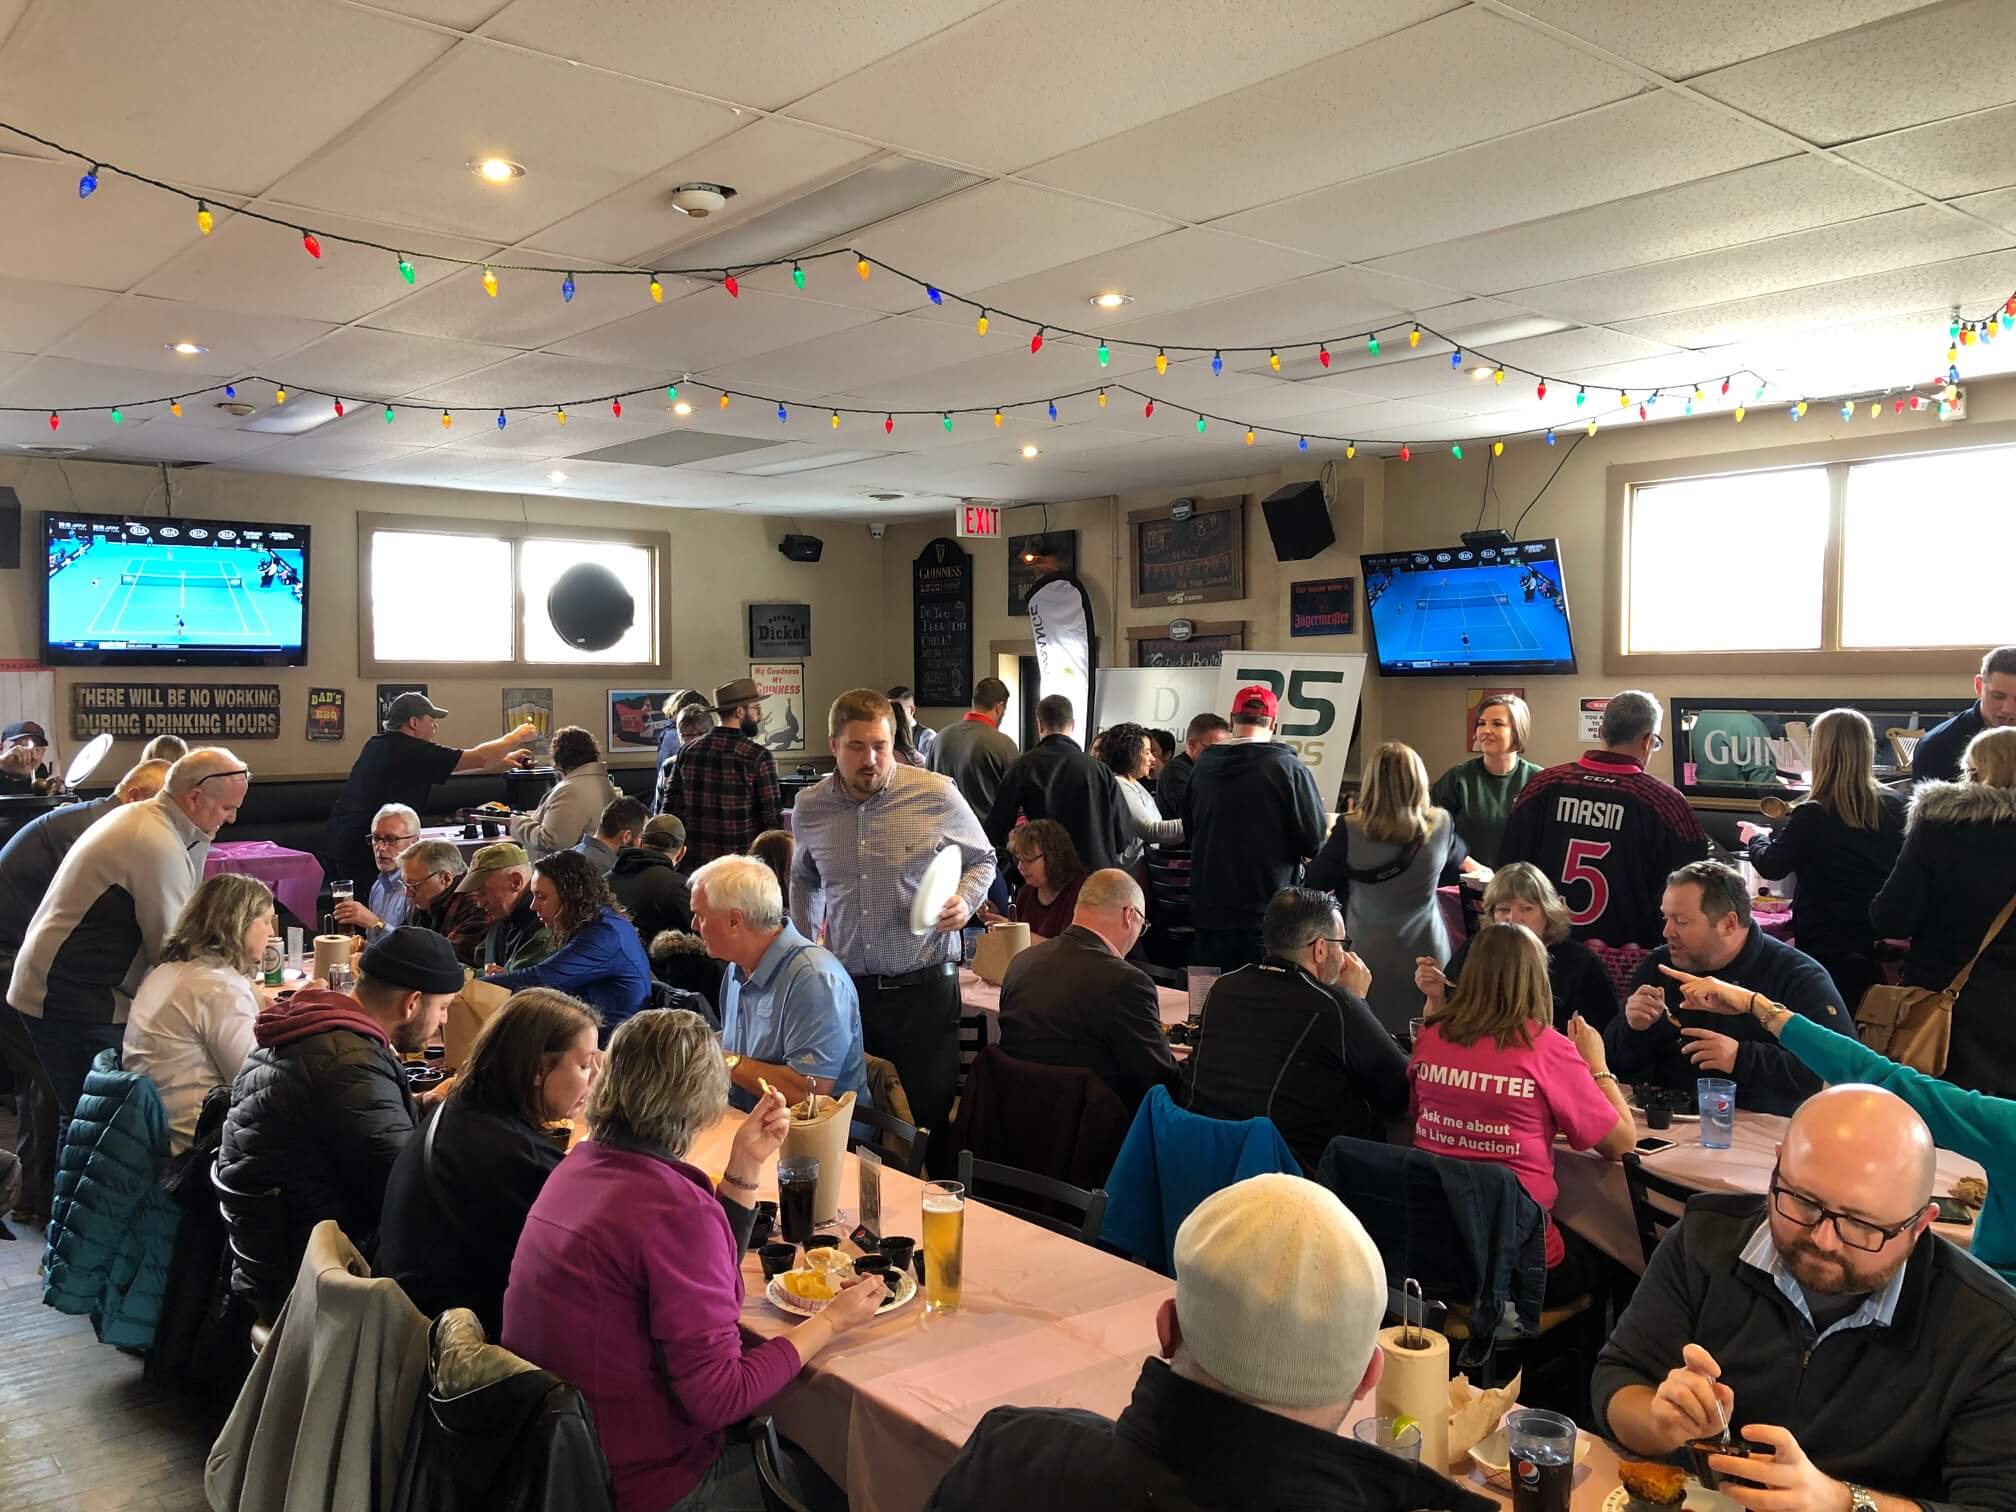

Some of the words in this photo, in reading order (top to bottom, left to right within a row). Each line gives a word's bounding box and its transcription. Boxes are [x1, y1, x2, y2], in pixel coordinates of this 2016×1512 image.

[966, 508, 999, 535] EXIT
[919, 566, 962, 579] GUINNESS
[759, 624, 805, 640] Dickel
[767, 667, 800, 675] Goodness
[79, 688, 125, 707] THERE
[129, 688, 164, 707] WILL
[168, 689, 186, 707] BE
[190, 689, 209, 707] NO
[214, 689, 279, 707] WORKING
[311, 691, 342, 705] DAD'S
[756, 682, 801, 694] GUINNESS
[1151, 687, 1180, 722] D
[77, 713, 141, 734] DURING
[145, 713, 221, 735] DRINKING
[225, 713, 276, 734] HOURS
[1704, 729, 1810, 769] GUINN
[1583, 774, 1617, 784] CCM
[1556, 796, 1625, 831] MASIN
[1559, 838, 1613, 926] 5
[1422, 1108, 1440, 1124] Ask
[1443, 1116, 1463, 1129] me
[1466, 1119, 1511, 1136] about
[1415, 1122, 1428, 1138] he
[1430, 1128, 1456, 1145] Live
[1458, 1136, 1521, 1155] Auction!
